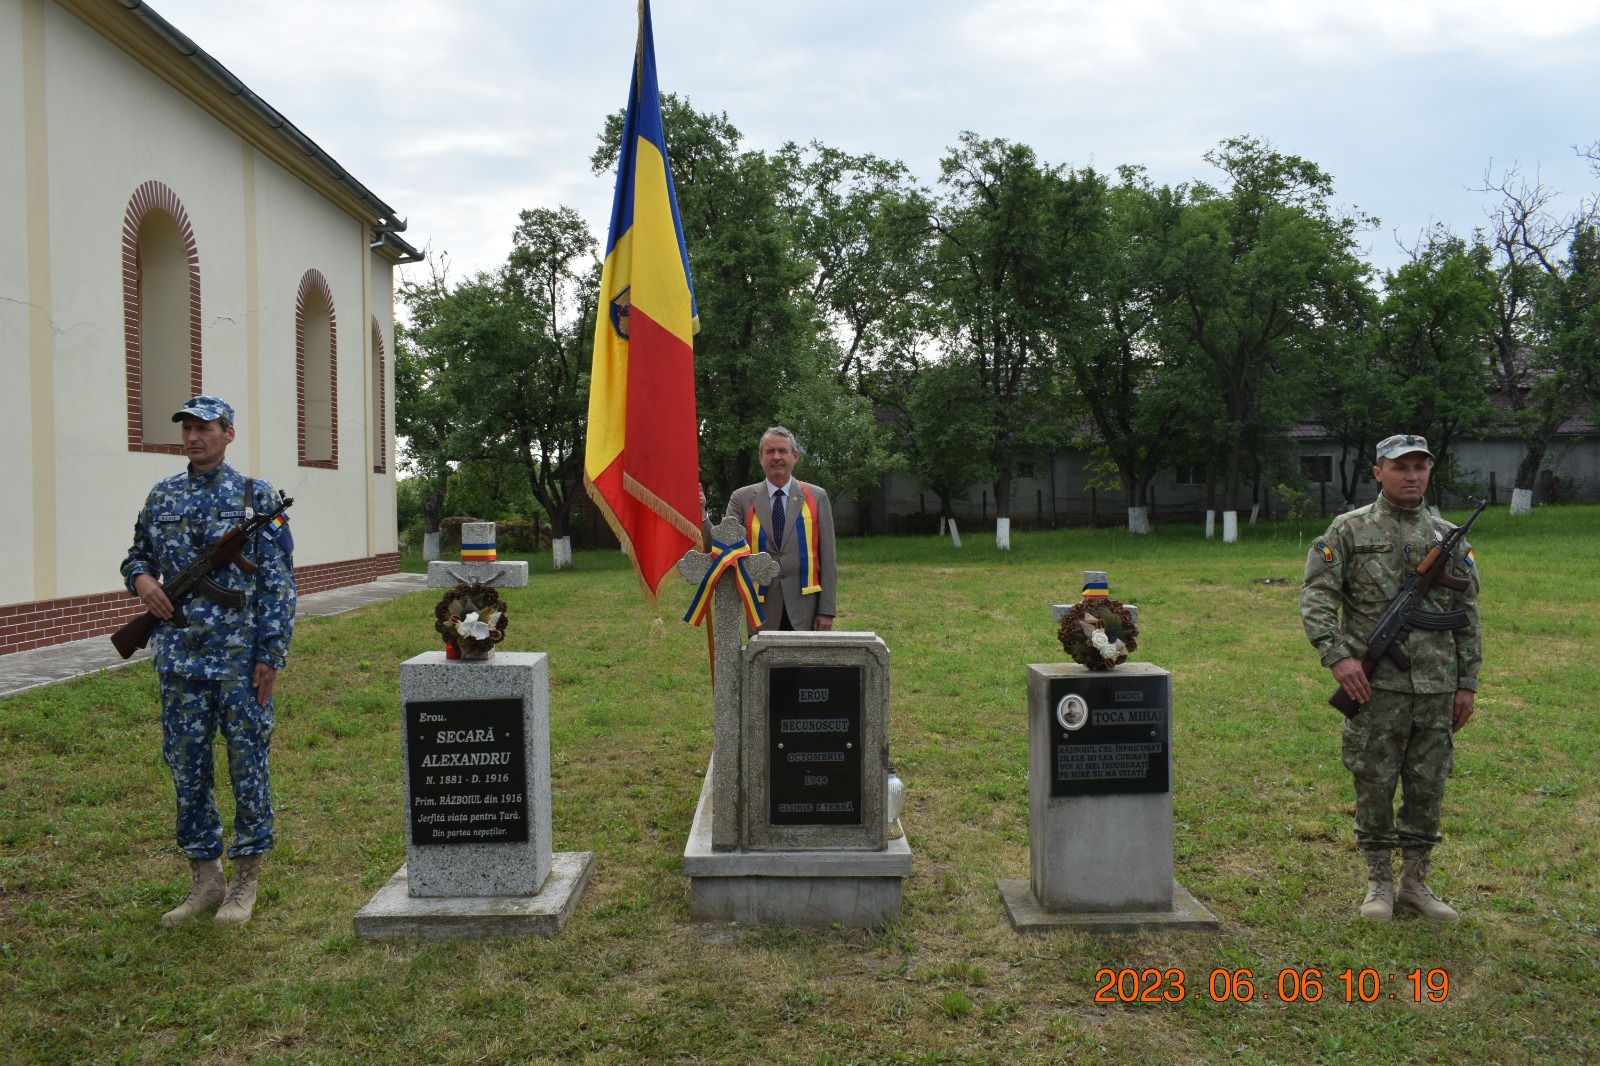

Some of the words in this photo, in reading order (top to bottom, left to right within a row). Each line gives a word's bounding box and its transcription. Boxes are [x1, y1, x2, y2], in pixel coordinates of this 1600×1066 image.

[800, 689, 828, 702] EROU
[1116, 692, 1142, 700] EROUL
[419, 712, 447, 722] Erou.
[782, 719, 850, 732] NECUNOSCUT
[436, 726, 494, 743] SECARĂ
[1059, 746, 1096, 754] RĂZBOIUL
[421, 752, 511, 767] ALEXANDRU
[788, 753, 844, 762] OCTOMBRIE
[426, 776, 435, 785] N.
[440, 775, 462, 784] 1881
[471, 775, 481, 783] D.
[485, 774, 509, 783] 1916
[414, 797, 437, 806] Prim.
[440, 794, 482, 805] RĂZBOIUL
[484, 795, 498, 803] din
[501, 794, 522, 803] 1916
[817, 802, 853, 811] ETERNĂ
[470, 812, 497, 823] pentru
[447, 829, 471, 838] partea
